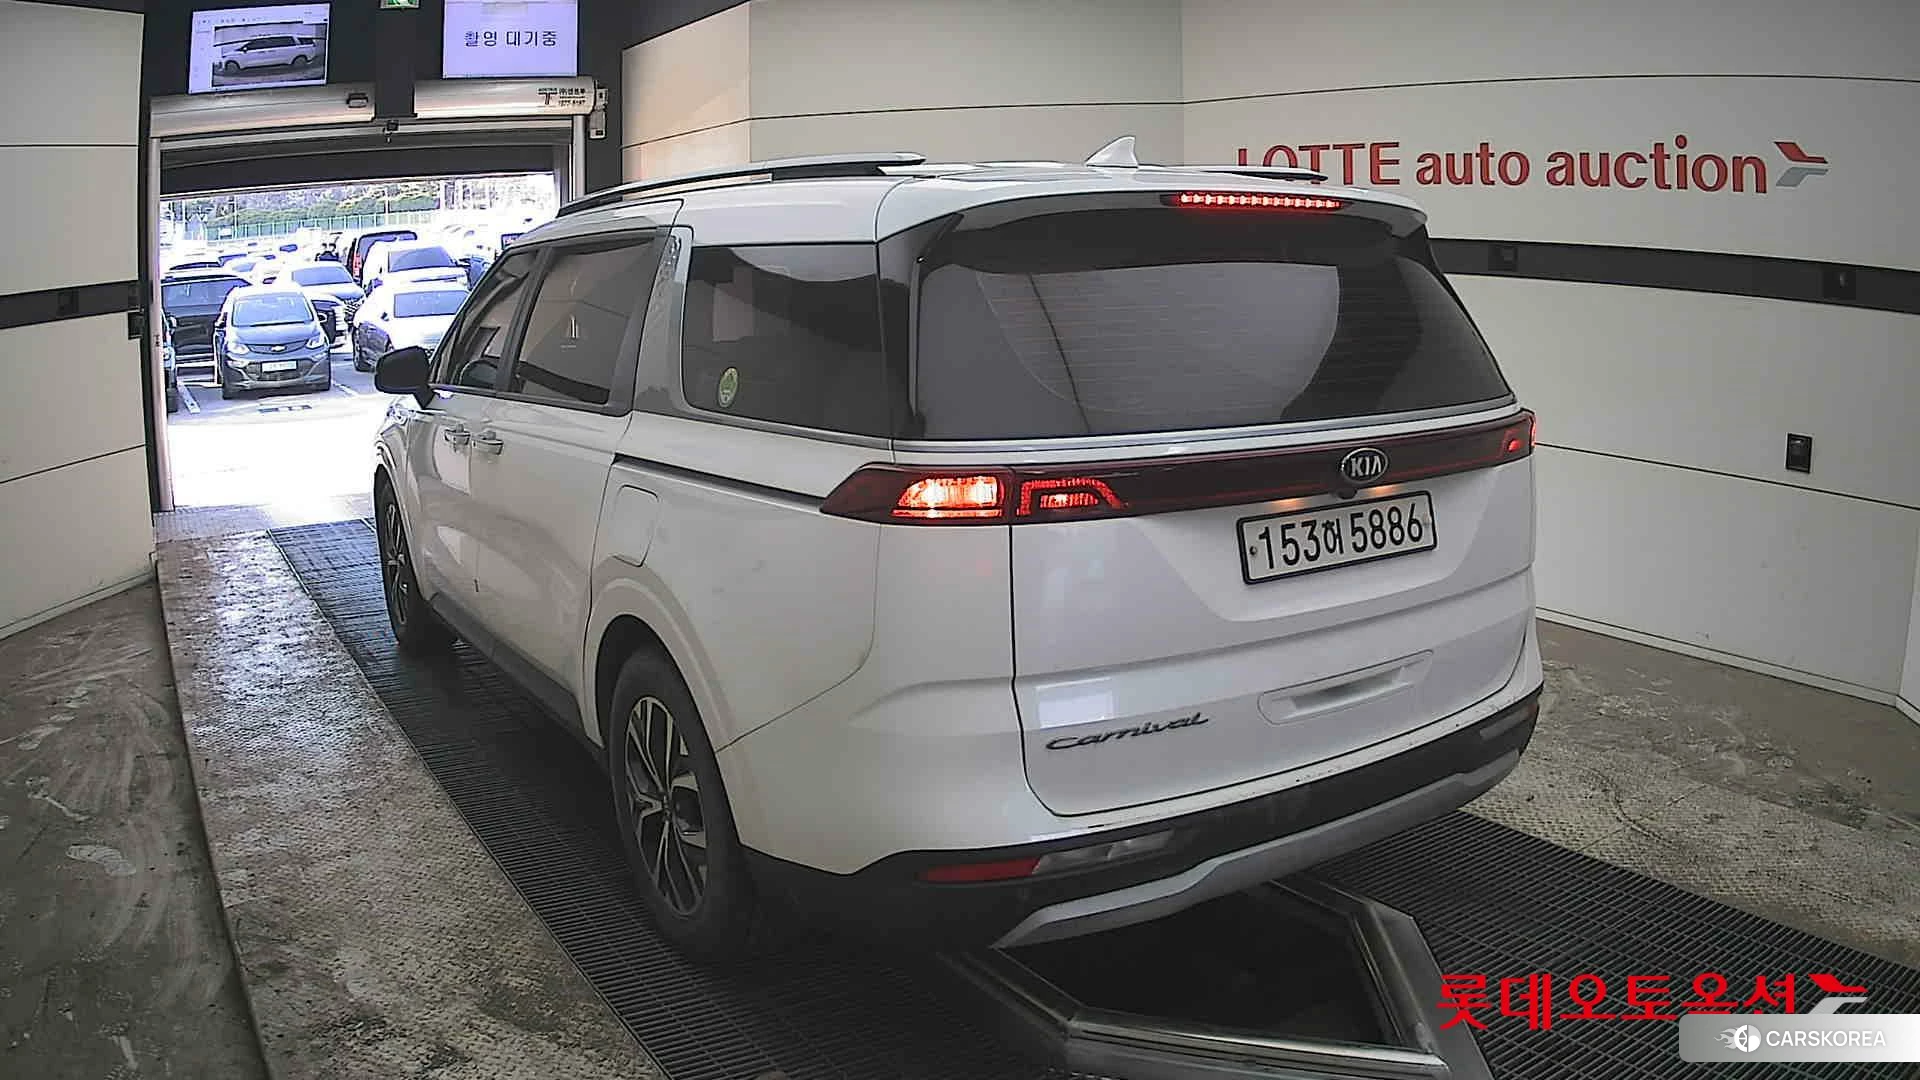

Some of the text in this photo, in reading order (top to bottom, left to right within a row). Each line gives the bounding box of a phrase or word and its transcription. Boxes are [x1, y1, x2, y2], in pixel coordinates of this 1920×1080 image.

[505, 31, 557, 47] 대기중
[1416, 144, 1530, 186] auto
[1546, 135, 1767, 193] auction
[1350, 456, 1382, 478] KIA
[1350, 503, 1423, 553] 5886
[1046, 702, 1209, 750] Carnival
